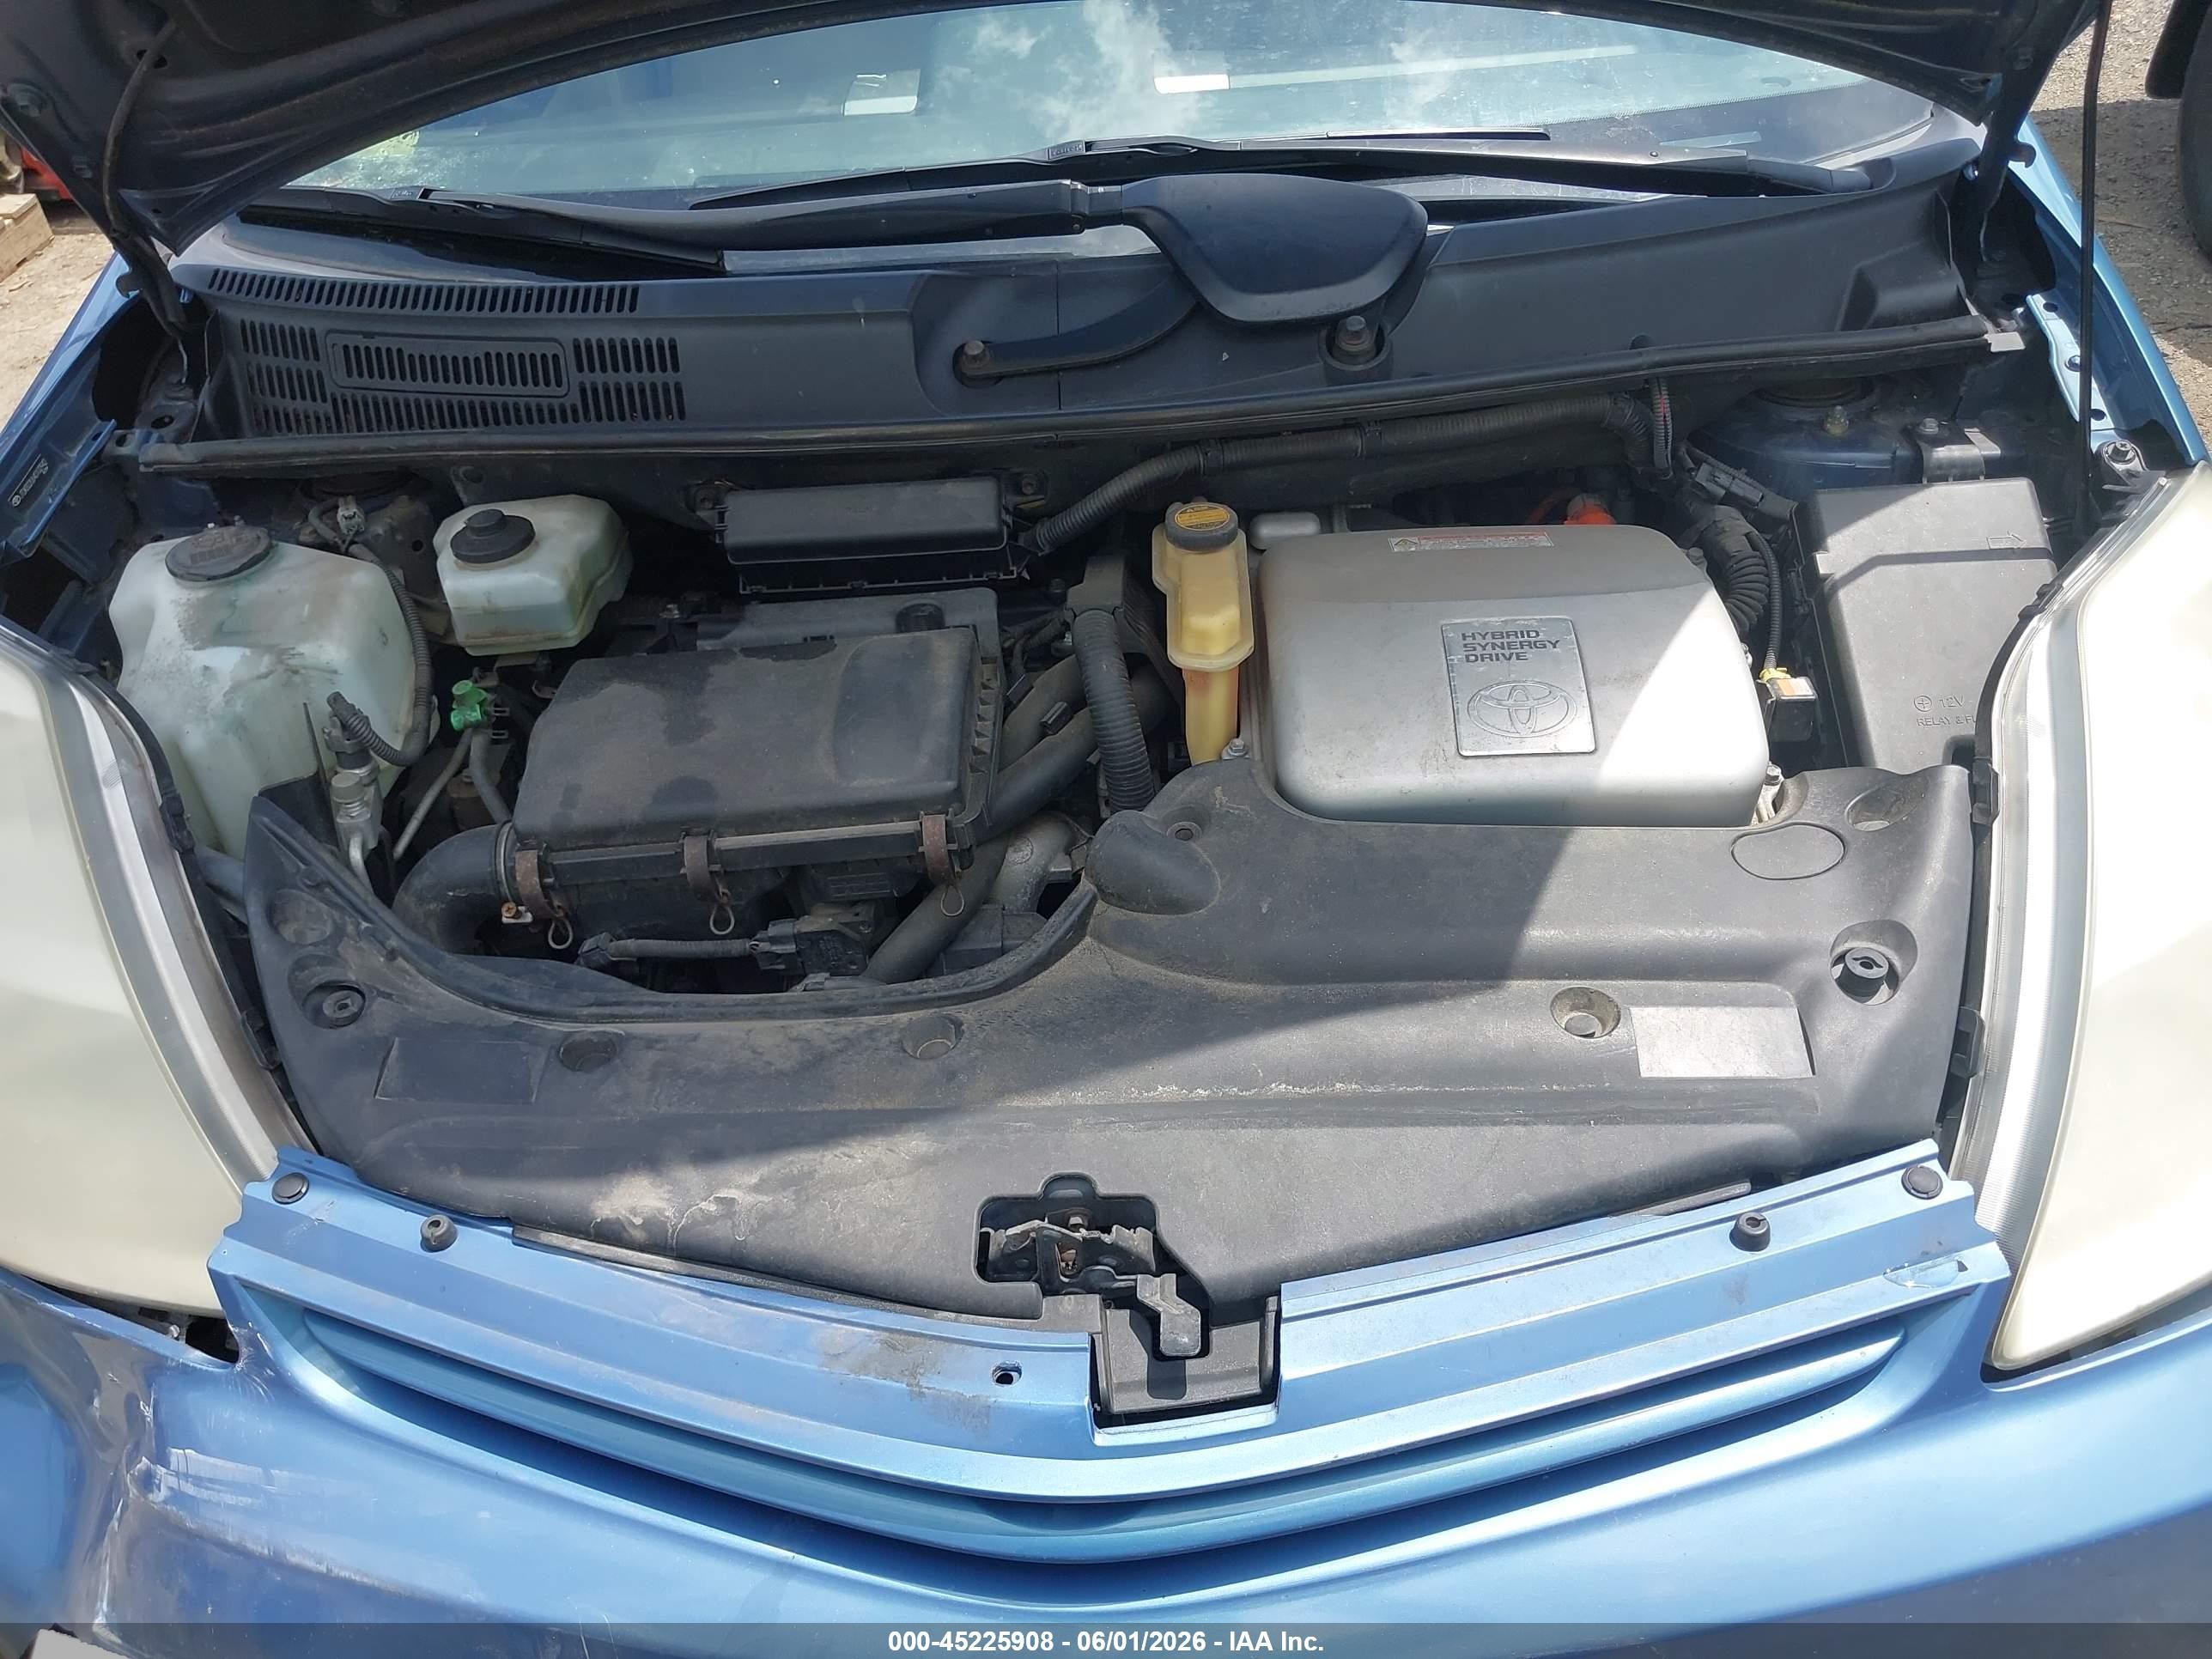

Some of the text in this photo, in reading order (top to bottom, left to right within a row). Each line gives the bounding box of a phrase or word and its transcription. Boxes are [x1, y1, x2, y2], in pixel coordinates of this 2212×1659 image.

[1462, 629, 1540, 641] HYBRID
[1463, 640, 1560, 652] SYNERGY
[1465, 652, 1528, 663] DRIVE
[1939, 695, 1964, 708] 12V
[1916, 716, 1951, 726] RELAY
